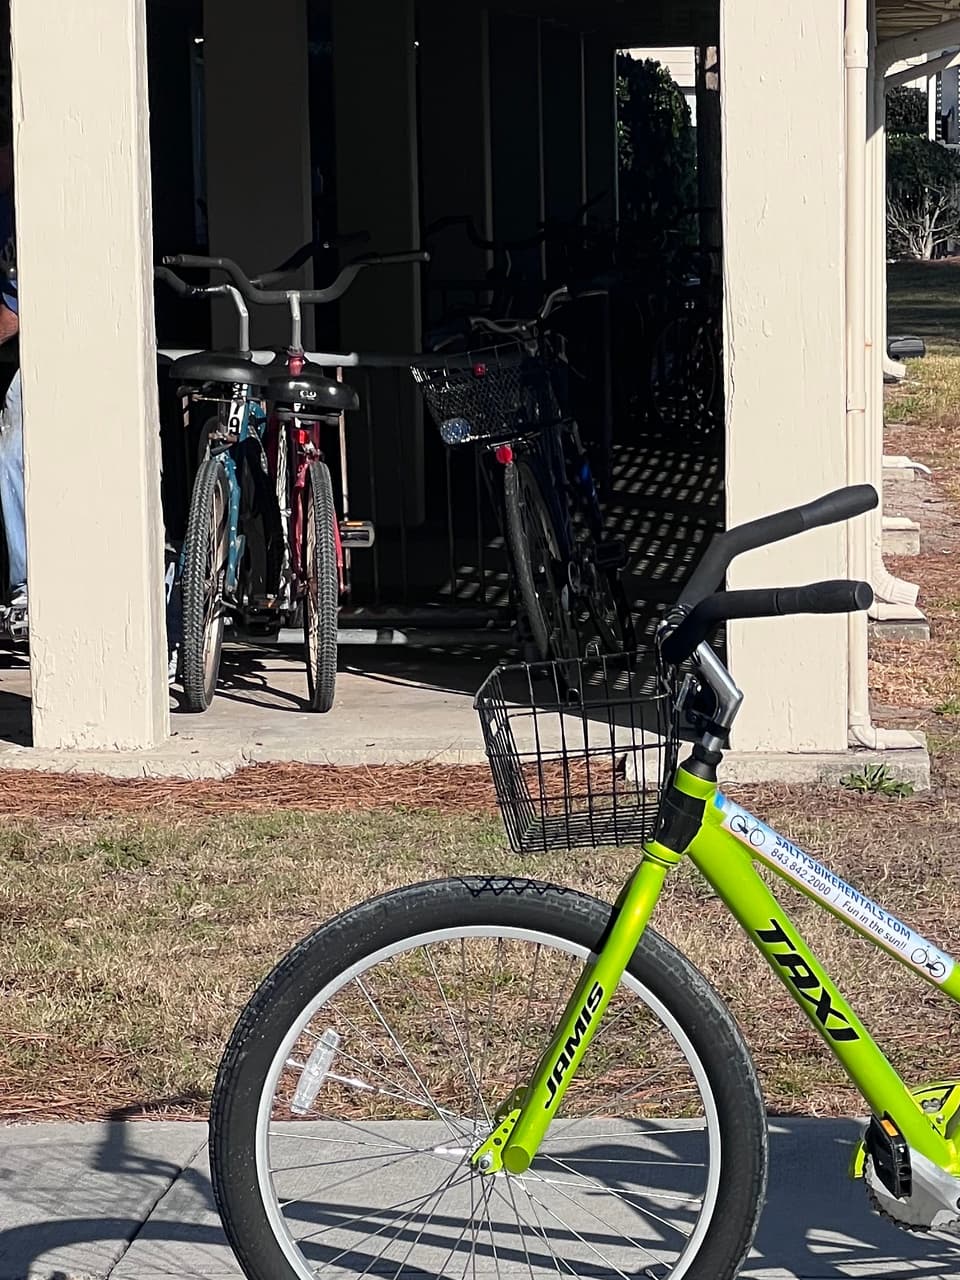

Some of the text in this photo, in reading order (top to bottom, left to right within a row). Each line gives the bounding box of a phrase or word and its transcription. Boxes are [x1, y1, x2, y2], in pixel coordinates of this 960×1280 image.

[771, 848, 831, 896] 843.842.2000
[842, 901, 860, 917] Fun
[860, 913, 869, 924] in
[869, 920, 884, 935] the
[883, 932, 907, 950] sun!!
[775, 835, 911, 941] SALTYSBIKERENTALS.COM
[755, 918, 860, 1041] TAXI
[544, 981, 604, 1109] JAMIS
